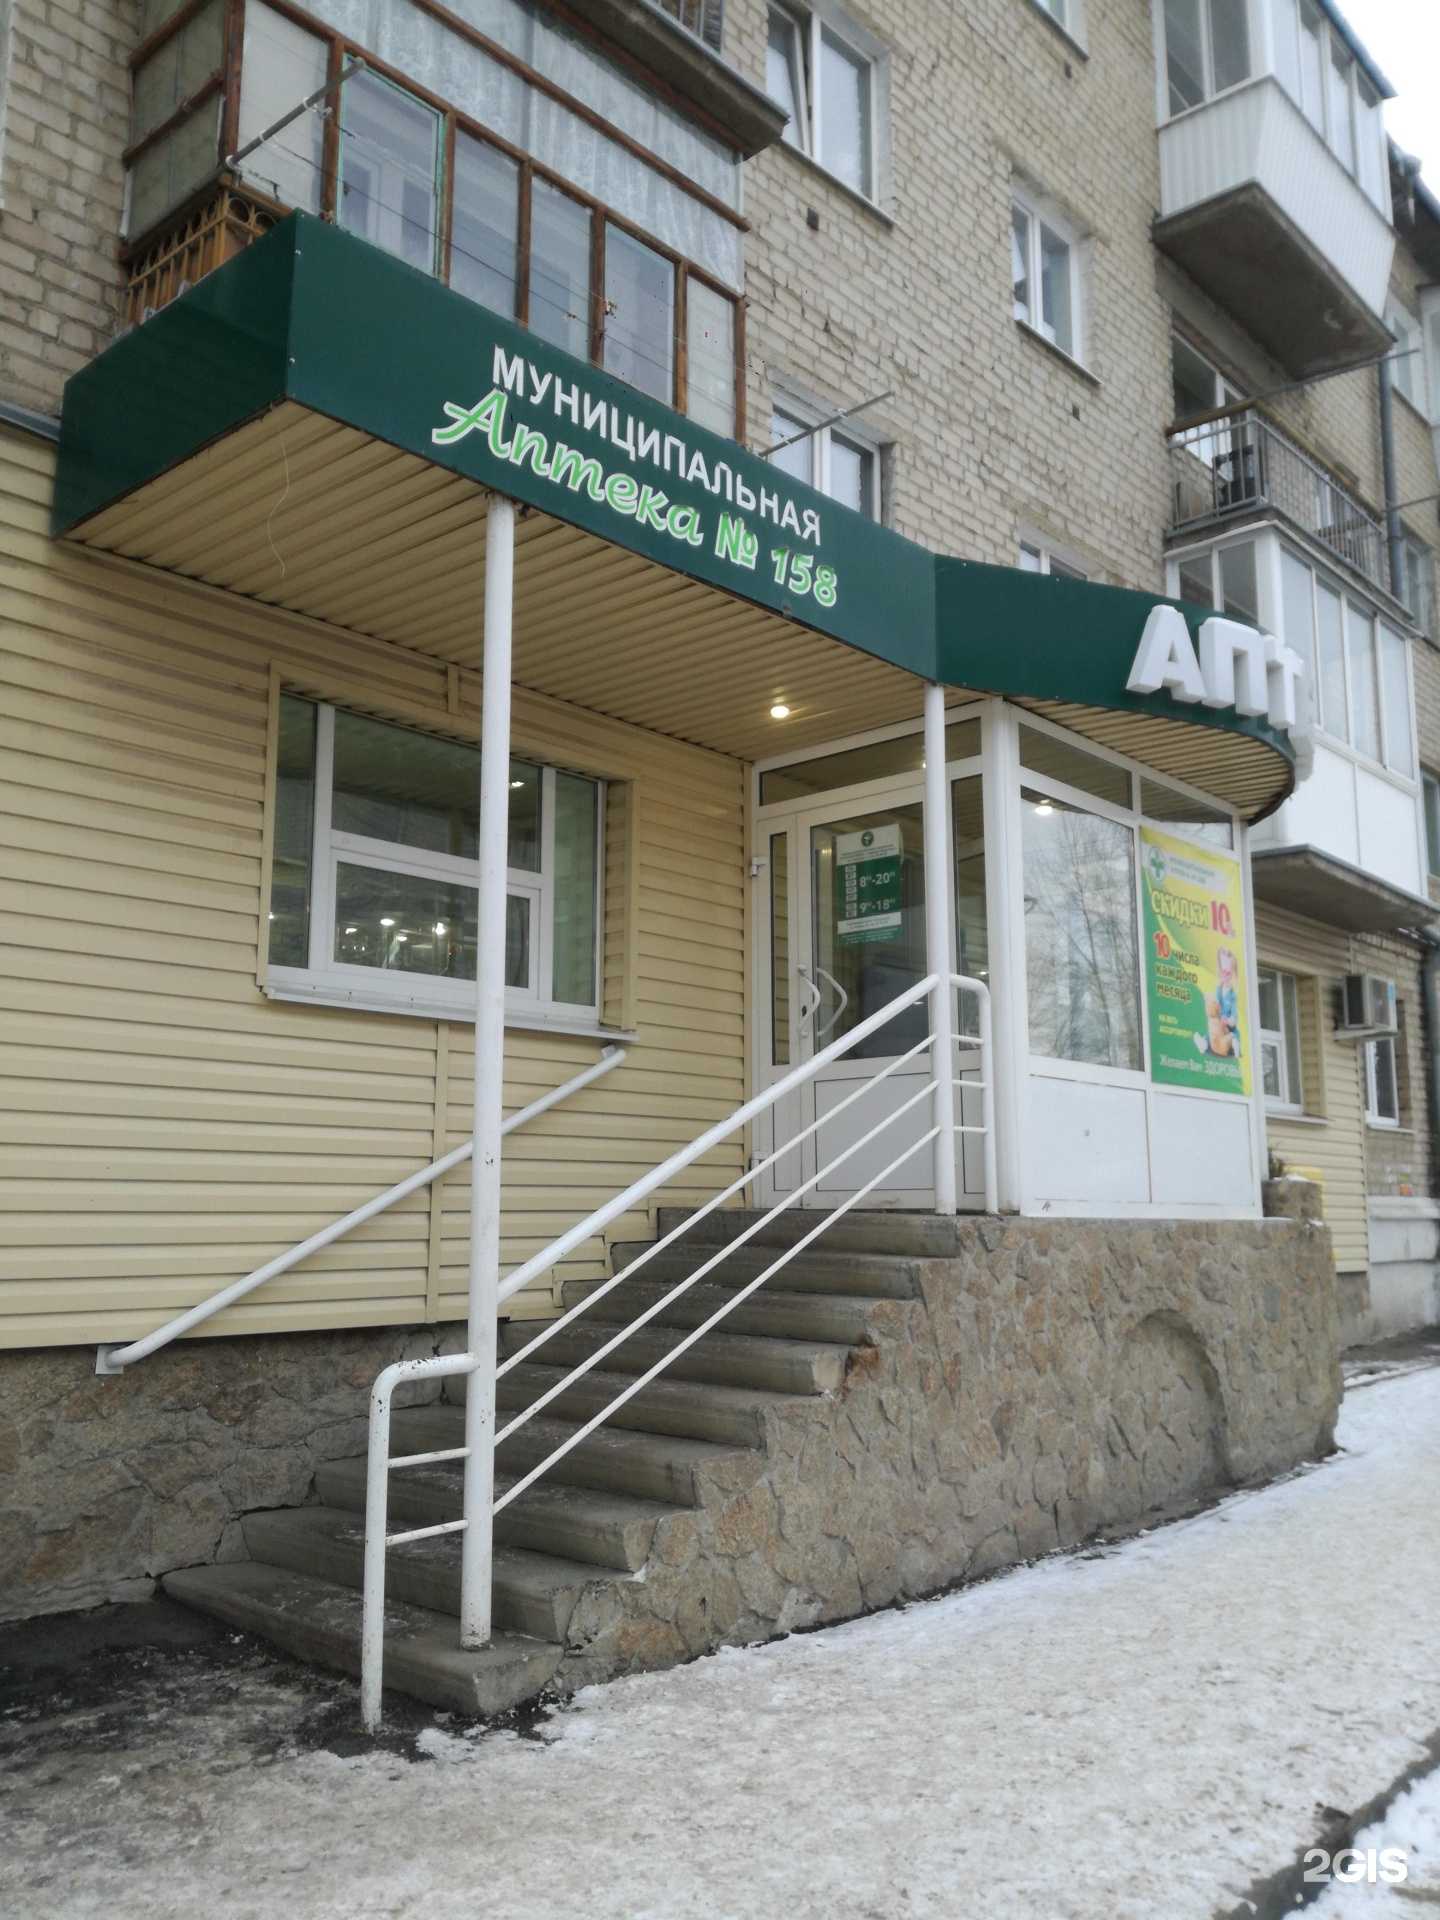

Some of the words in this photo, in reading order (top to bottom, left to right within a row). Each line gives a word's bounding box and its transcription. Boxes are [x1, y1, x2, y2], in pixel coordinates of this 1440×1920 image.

[431, 388, 704, 547] Аптека
[714, 511, 759, 570] №
[770, 545, 838, 608] 158
[492, 344, 822, 546] МУНИЦИПАЛЬНАЯ
[1153, 930, 1171, 959] 10
